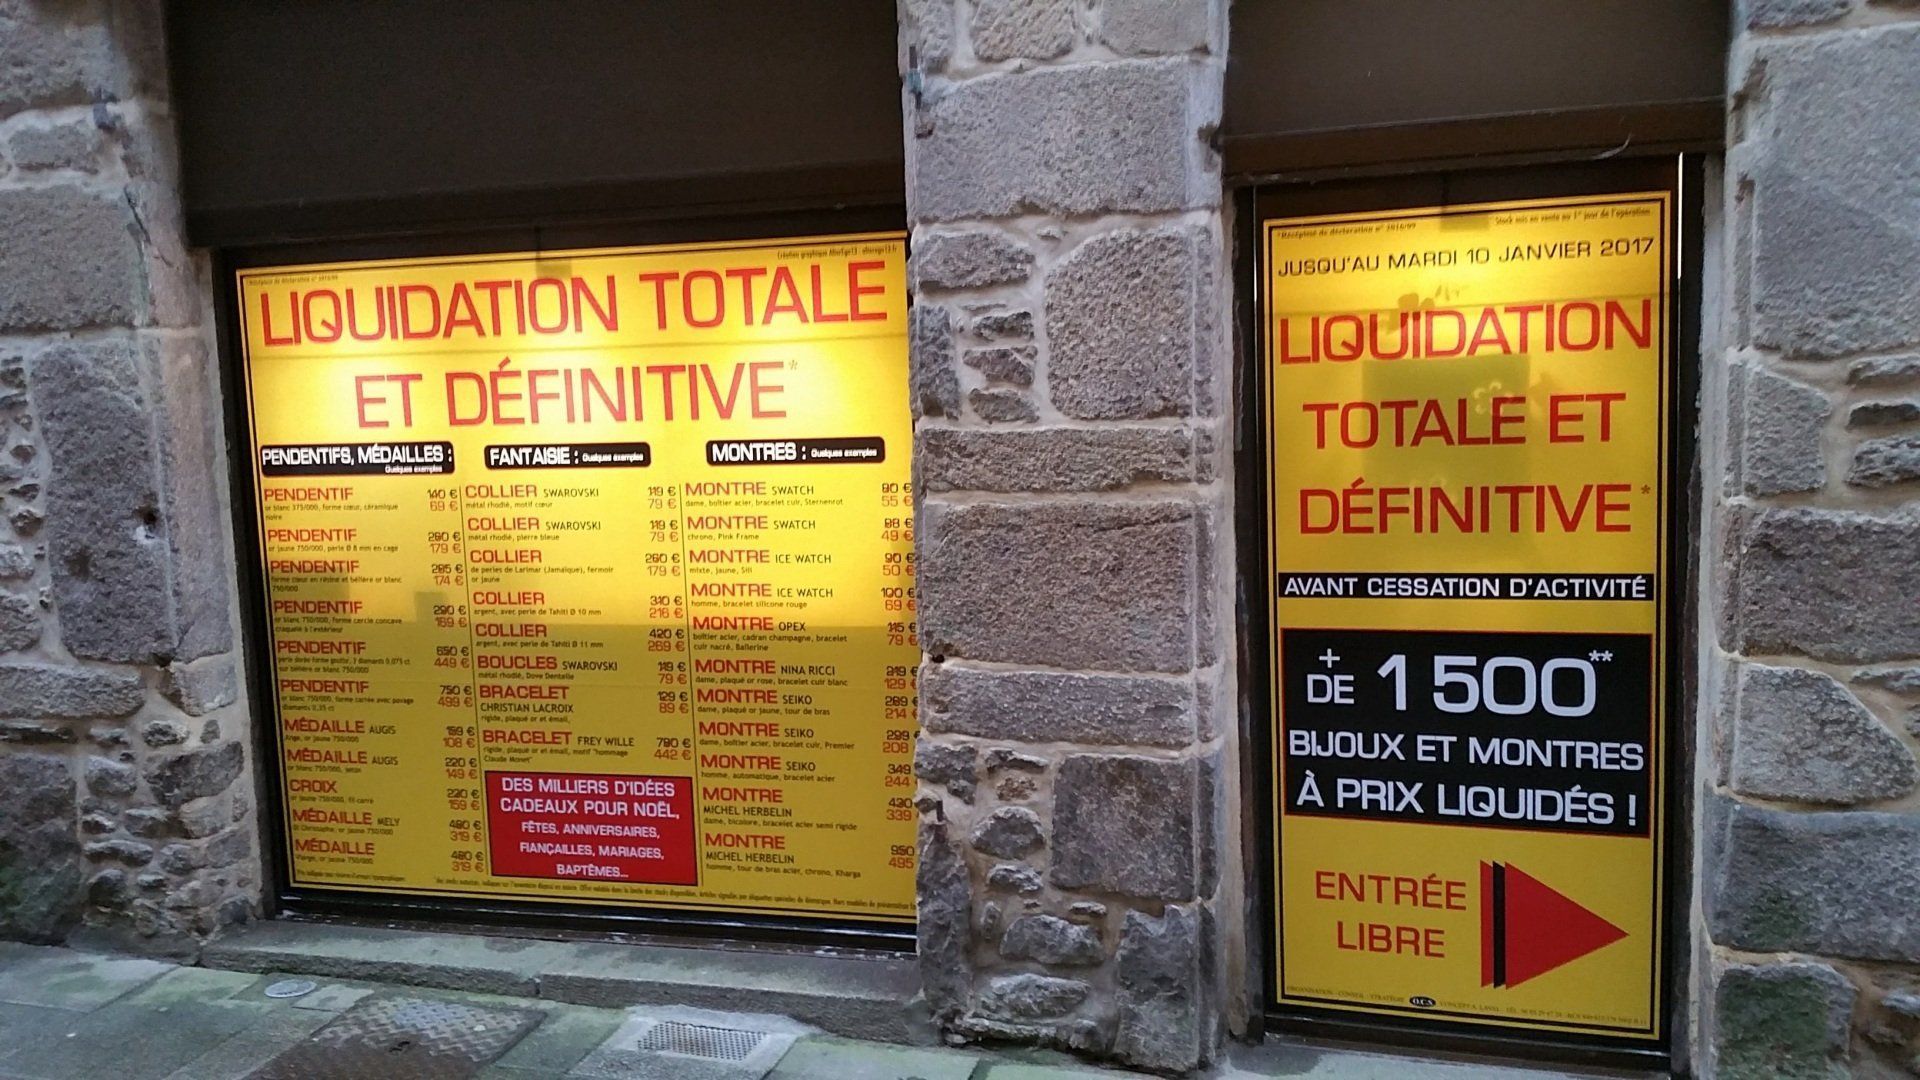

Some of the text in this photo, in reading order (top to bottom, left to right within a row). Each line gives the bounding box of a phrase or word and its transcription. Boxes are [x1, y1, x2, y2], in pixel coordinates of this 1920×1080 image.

[1278, 237, 1655, 277] JUSQU'AU MARDI 10 JANVIER 2017
[261, 261, 888, 347] LIQUIDATION TOTALE
[1280, 299, 1651, 365] LIQUIDATION
[356, 374, 423, 429] ET
[1302, 393, 1626, 449] TOTALE ET
[262, 446, 354, 466] PENDENTIFS,
[358, 443, 444, 465] MÉDAILLES
[490, 446, 571, 466] FANTAISIE
[712, 442, 797, 462] MONTRES
[264, 488, 354, 502] PENDENTIF
[465, 485, 600, 499] COLLIER SWAROVSKI
[685, 482, 814, 497] MONTRE SWATCH
[881, 496, 899, 507] 55
[467, 517, 601, 531] COLLIER SWAROVSKI
[687, 515, 816, 530] MONTRE SWATCH
[267, 528, 357, 542] PENDENTIF
[881, 530, 899, 541] 49
[470, 550, 543, 564] COLLIER
[689, 549, 832, 564] MONTRE ICE WATCH
[270, 560, 360, 574] PENDENTIF
[648, 565, 667, 576] 179
[882, 565, 901, 576] 50
[691, 583, 833, 598] MONTRE ICE WATCH
[1284, 574, 1646, 599] AVANT CESSATION D'ACTIVITÉ
[473, 592, 545, 605] COLLIER
[885, 600, 902, 611] 69
[274, 601, 363, 614] PENDENTIF
[475, 623, 548, 638] COLLIER
[693, 616, 807, 632] MONTRE OPEX
[277, 640, 367, 655] PENDENTIF
[887, 634, 904, 646] 79
[477, 655, 618, 672] BOUCLES SWAROVSKI
[1318, 648, 1341, 669] +
[695, 659, 836, 676] MONTRE NINA RICCI
[280, 679, 370, 694] PENDENTIF
[659, 674, 674, 684] 79
[479, 685, 569, 700] BRACELET
[697, 689, 813, 705] MONTRE SEIKO
[1306, 673, 1354, 705] DE
[480, 702, 574, 713] CHRISTIAN LACROIX
[284, 717, 397, 735] MÉDAILLE AUGIS
[699, 722, 815, 738] MONTRE SEIKO
[482, 730, 635, 747] BRACELET FREY WILLE
[286, 747, 368, 764] MÉDAILLE
[653, 749, 678, 760] 442
[1289, 729, 1644, 772] BIJOUX ET MONTRES
[701, 755, 817, 772] MONTRE SEIKO
[289, 778, 338, 793] CROIX
[502, 777, 676, 797] DES MILLIERS D'IDÉES
[703, 787, 783, 803] MONTRE
[1295, 769, 1324, 808] À
[1337, 777, 1424, 814] PRIX
[1437, 784, 1615, 826] LIQUIDÉS
[500, 797, 680, 819] CADEAUX POUR NOËL,
[704, 805, 792, 818] MICHEL HERBELIN
[292, 808, 372, 826] MÉDAILLE
[521, 820, 661, 839] FÊTES, ANNIVERSAIRES,
[295, 838, 376, 855] MÉDAILLE
[705, 833, 786, 849] MONTRE
[520, 841, 665, 860] FIANÇAILLES, MARIAGES,
[706, 851, 794, 864] MICHEL HERBELIN
[888, 858, 914, 869] 495
[1315, 870, 1467, 912] ENTRÉE
[1337, 921, 1445, 958] LIBRE
